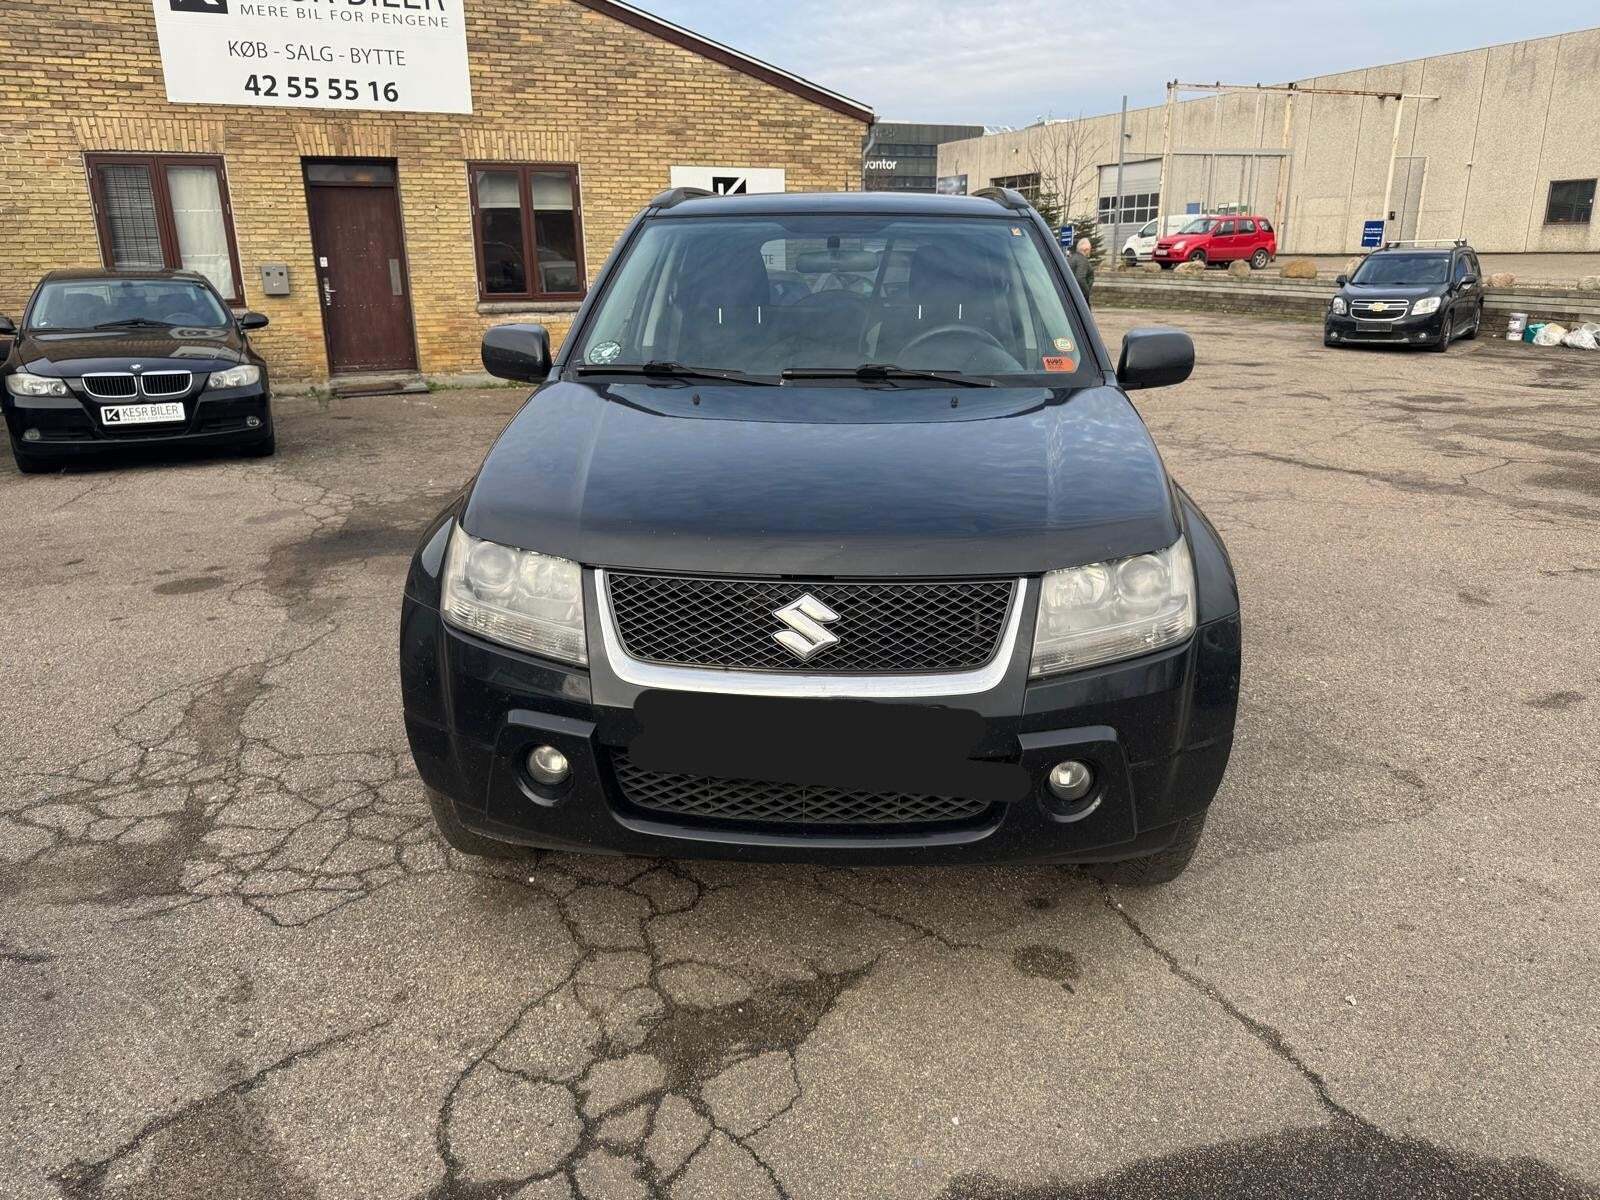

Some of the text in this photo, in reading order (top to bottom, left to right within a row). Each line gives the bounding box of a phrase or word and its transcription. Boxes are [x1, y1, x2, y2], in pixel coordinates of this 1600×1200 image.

[240, 4, 449, 28] MERE BIL FOR PENGENE
[228, 40, 268, 58] KØB
[285, 43, 334, 62] SALG
[350, 47, 407, 67] BYTTE
[244, 73, 400, 103] 42 55 55 16
[122, 407, 149, 417] KESR
[150, 405, 179, 416] BILER
